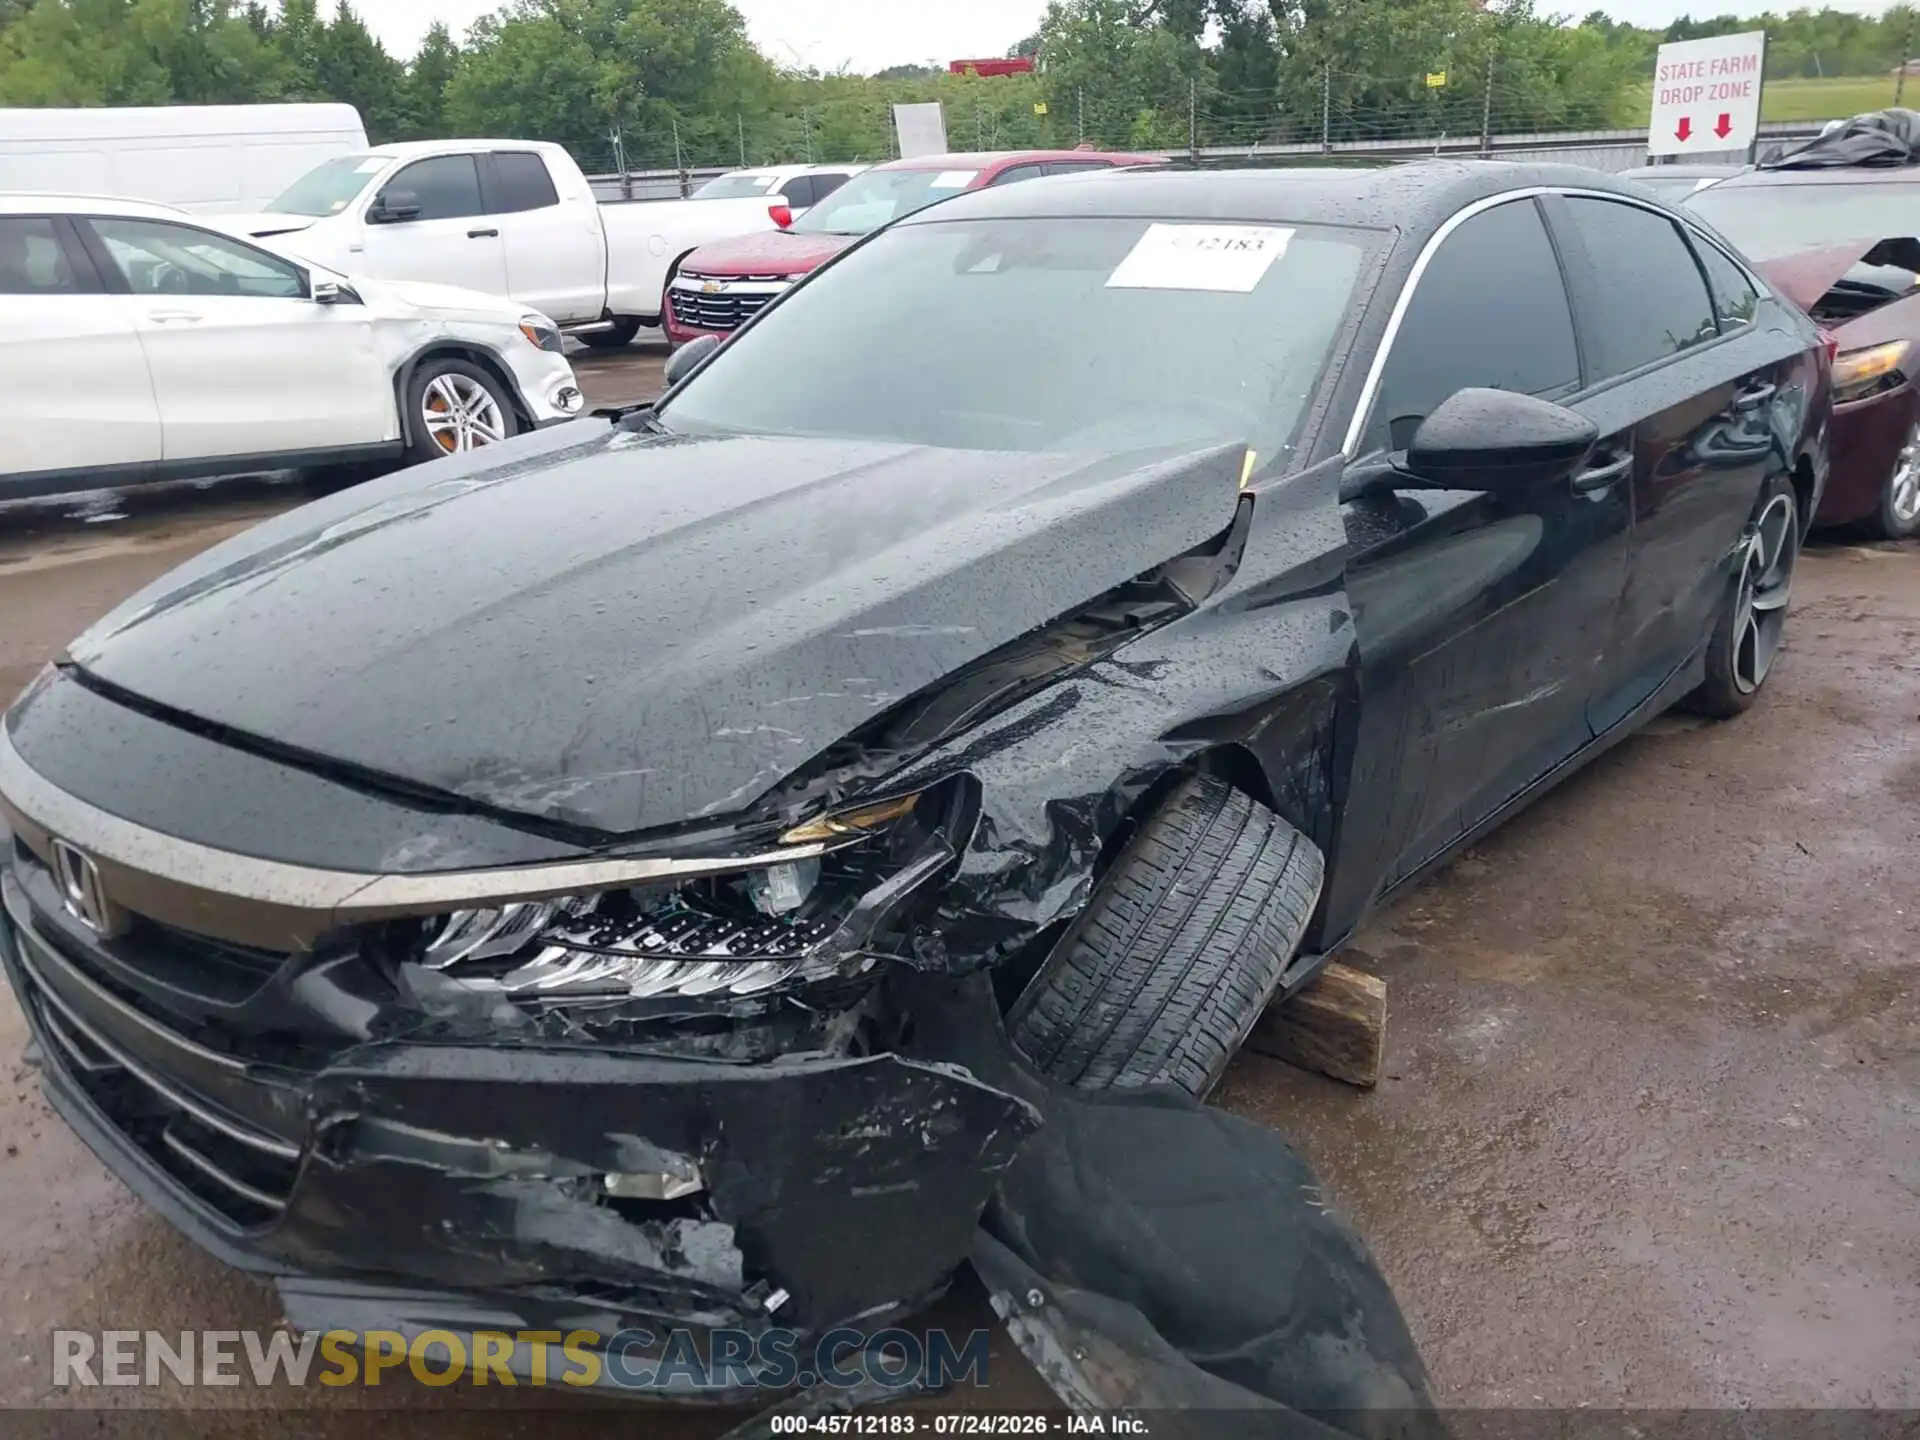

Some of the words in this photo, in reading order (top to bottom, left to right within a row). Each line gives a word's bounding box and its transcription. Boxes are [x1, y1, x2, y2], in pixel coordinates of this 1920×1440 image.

[1659, 60, 1706, 82] STATE
[1710, 54, 1758, 77] FARM
[1659, 86, 1704, 105] DROP
[1708, 80, 1753, 100] ZONE
